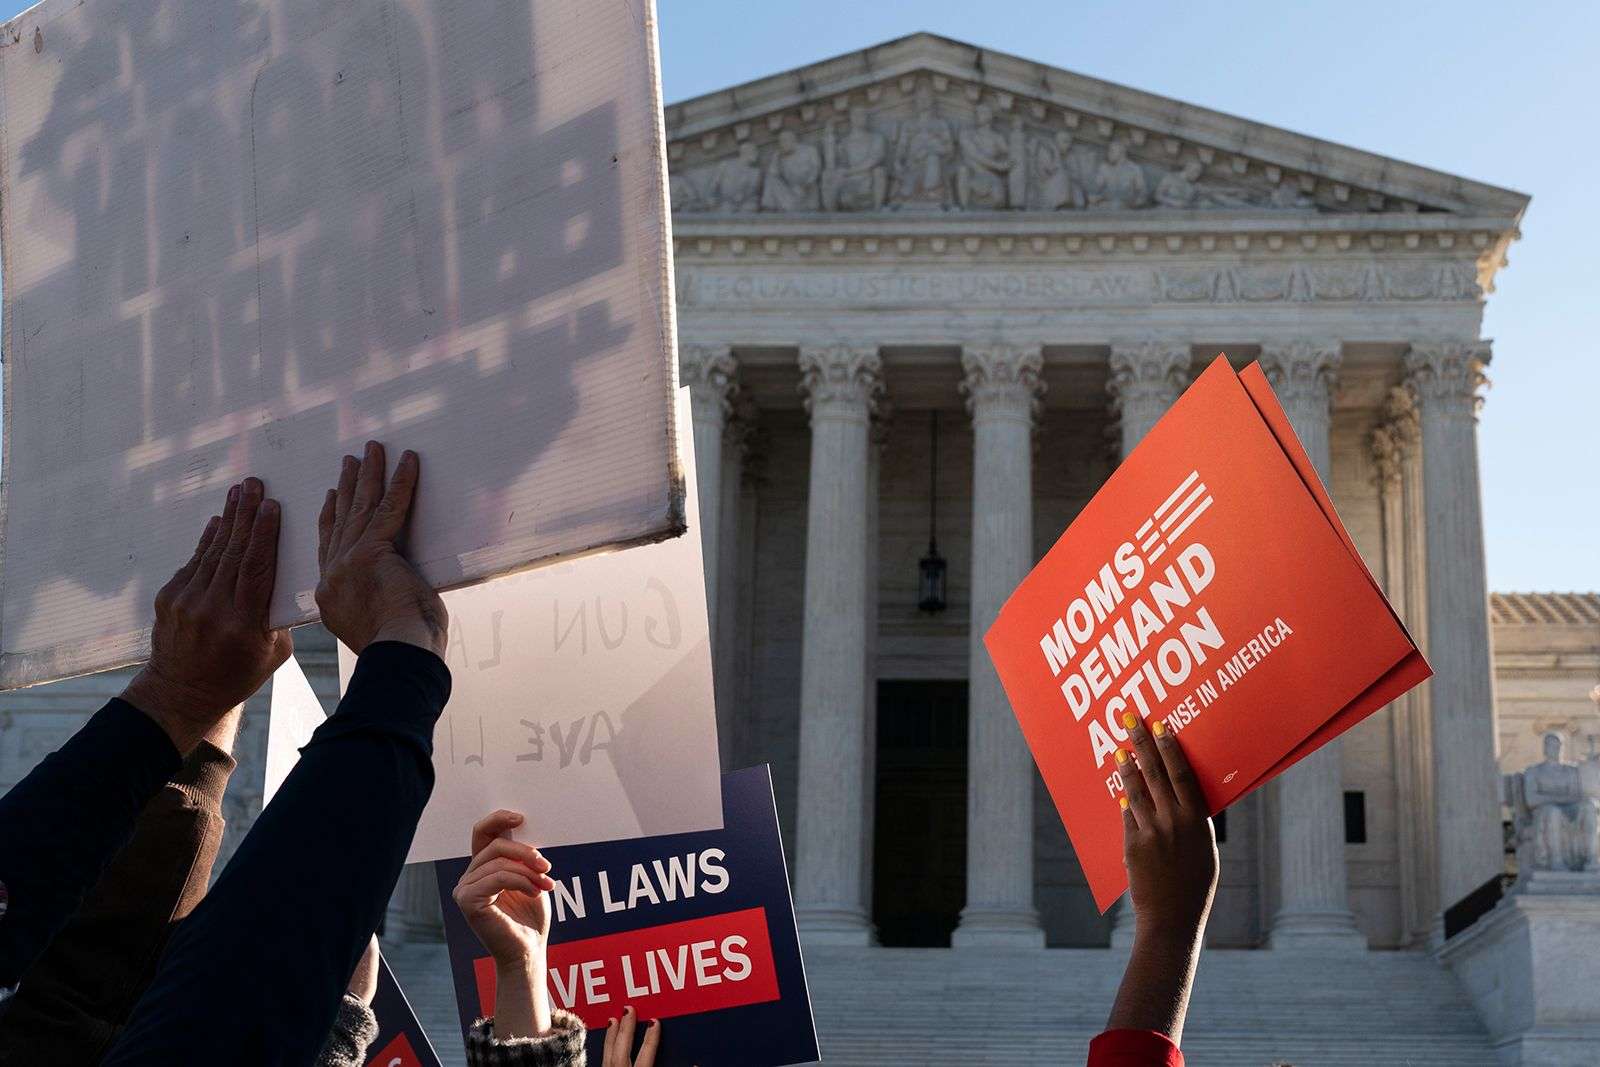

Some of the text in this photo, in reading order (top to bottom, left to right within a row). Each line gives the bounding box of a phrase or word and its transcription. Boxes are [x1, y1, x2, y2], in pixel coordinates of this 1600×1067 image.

[715, 275, 1132, 298] EQUAL JUSTICE UNDER LAW
[1039, 541, 1146, 677] MOMS
[1060, 543, 1216, 722] DEMAND
[1087, 606, 1226, 769] ACTION
[1196, 682, 1220, 708] IN
[1217, 616, 1294, 692] AMERICA
[598, 848, 730, 914] LAWS
[548, 935, 752, 1010] VE LIVES
